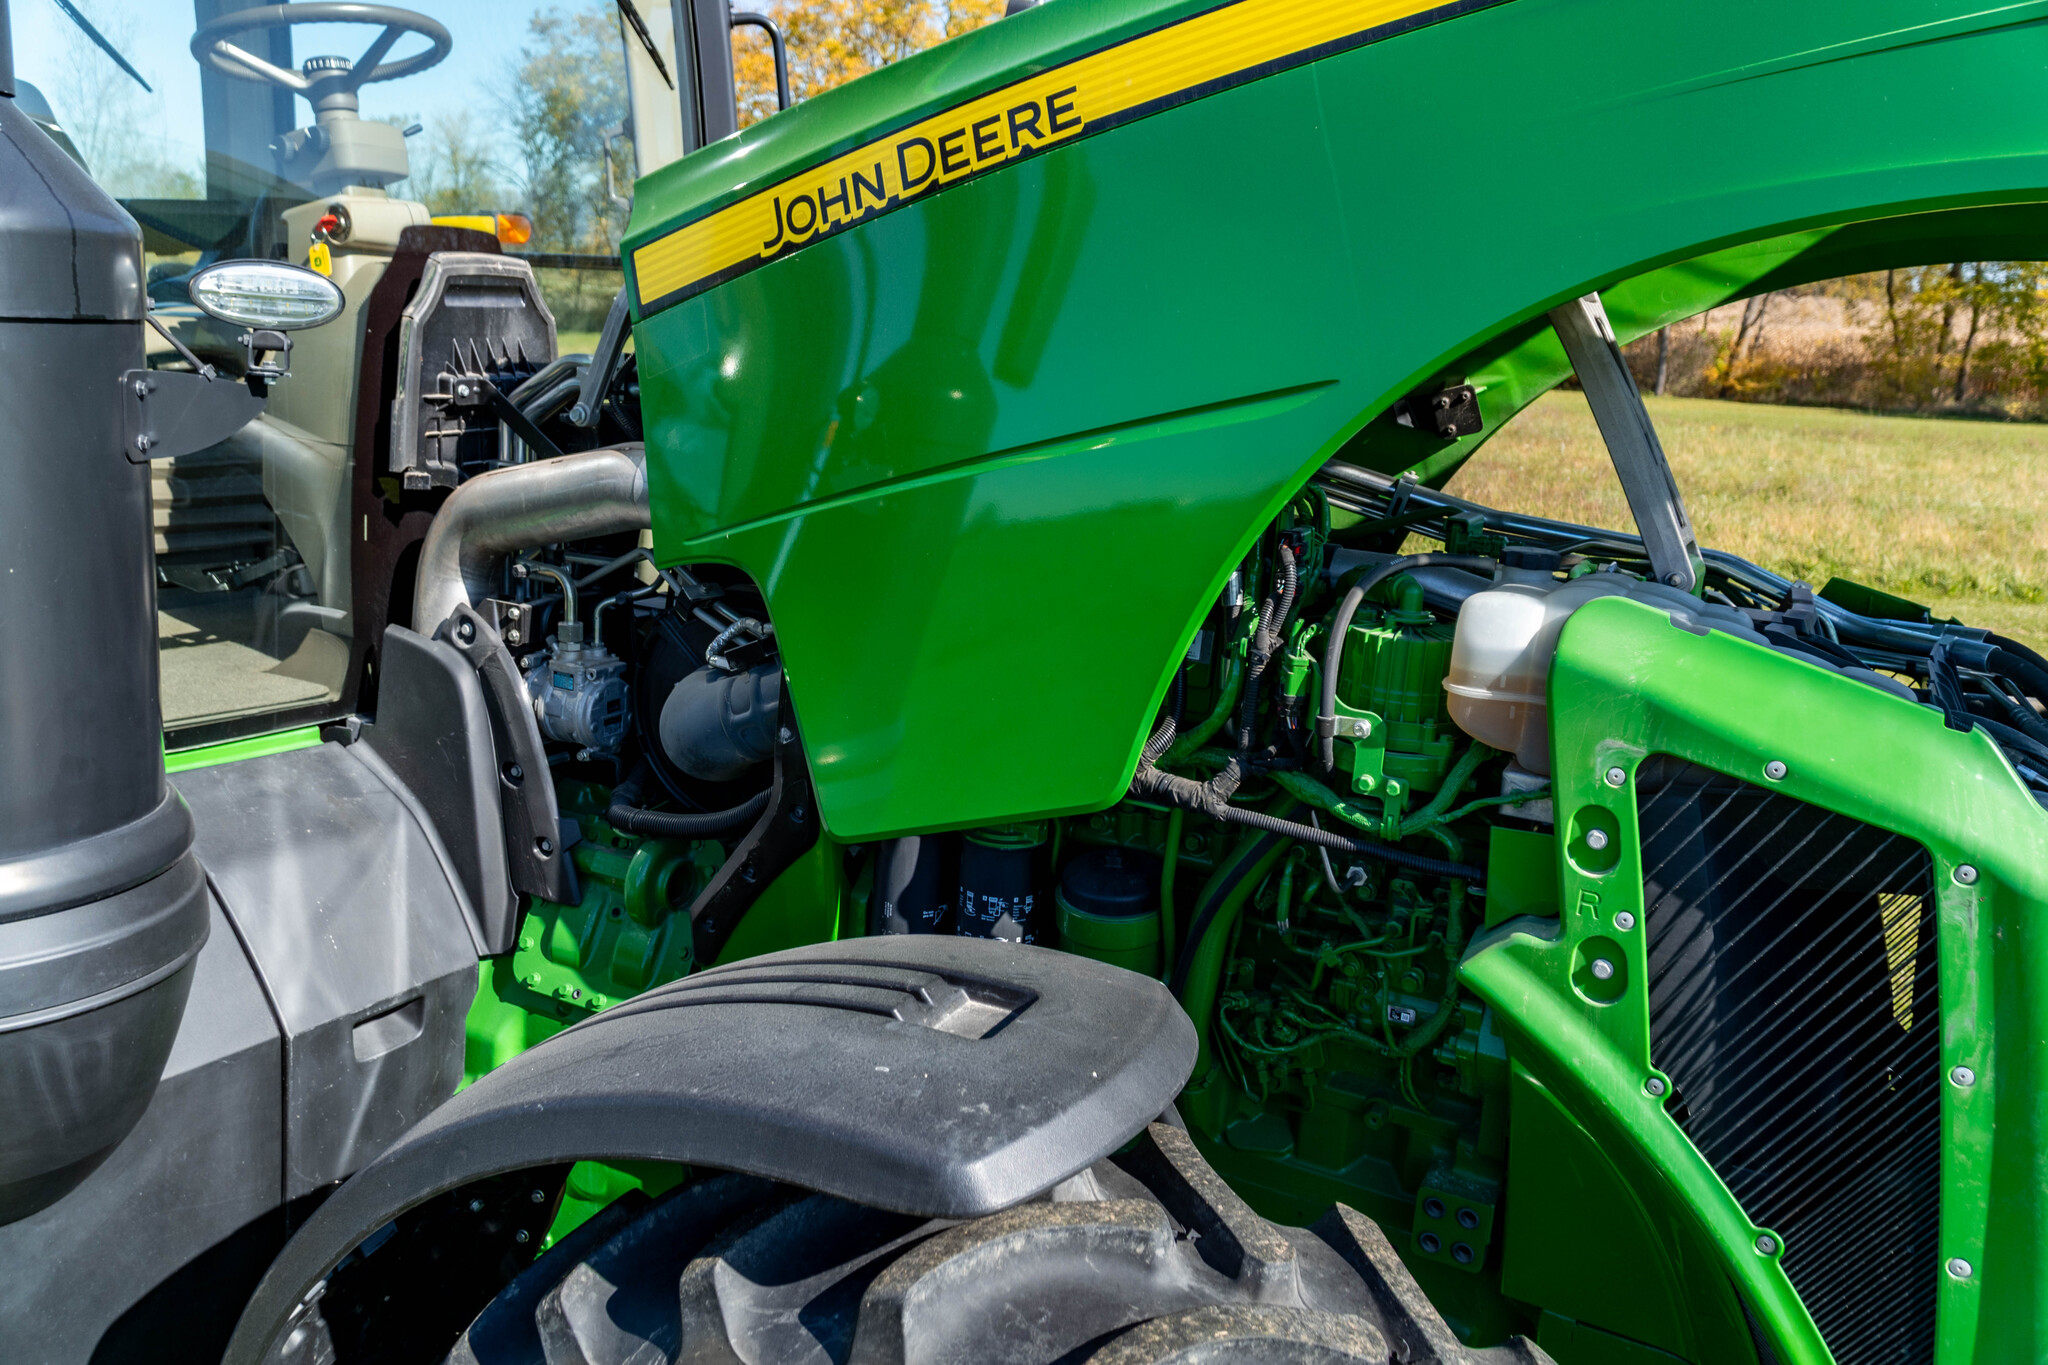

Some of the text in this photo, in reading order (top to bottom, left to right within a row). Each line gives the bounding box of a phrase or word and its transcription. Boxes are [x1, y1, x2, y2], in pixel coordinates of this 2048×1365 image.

[763, 85, 1083, 250] JOHN DEERE
[1575, 888, 1602, 920] R
